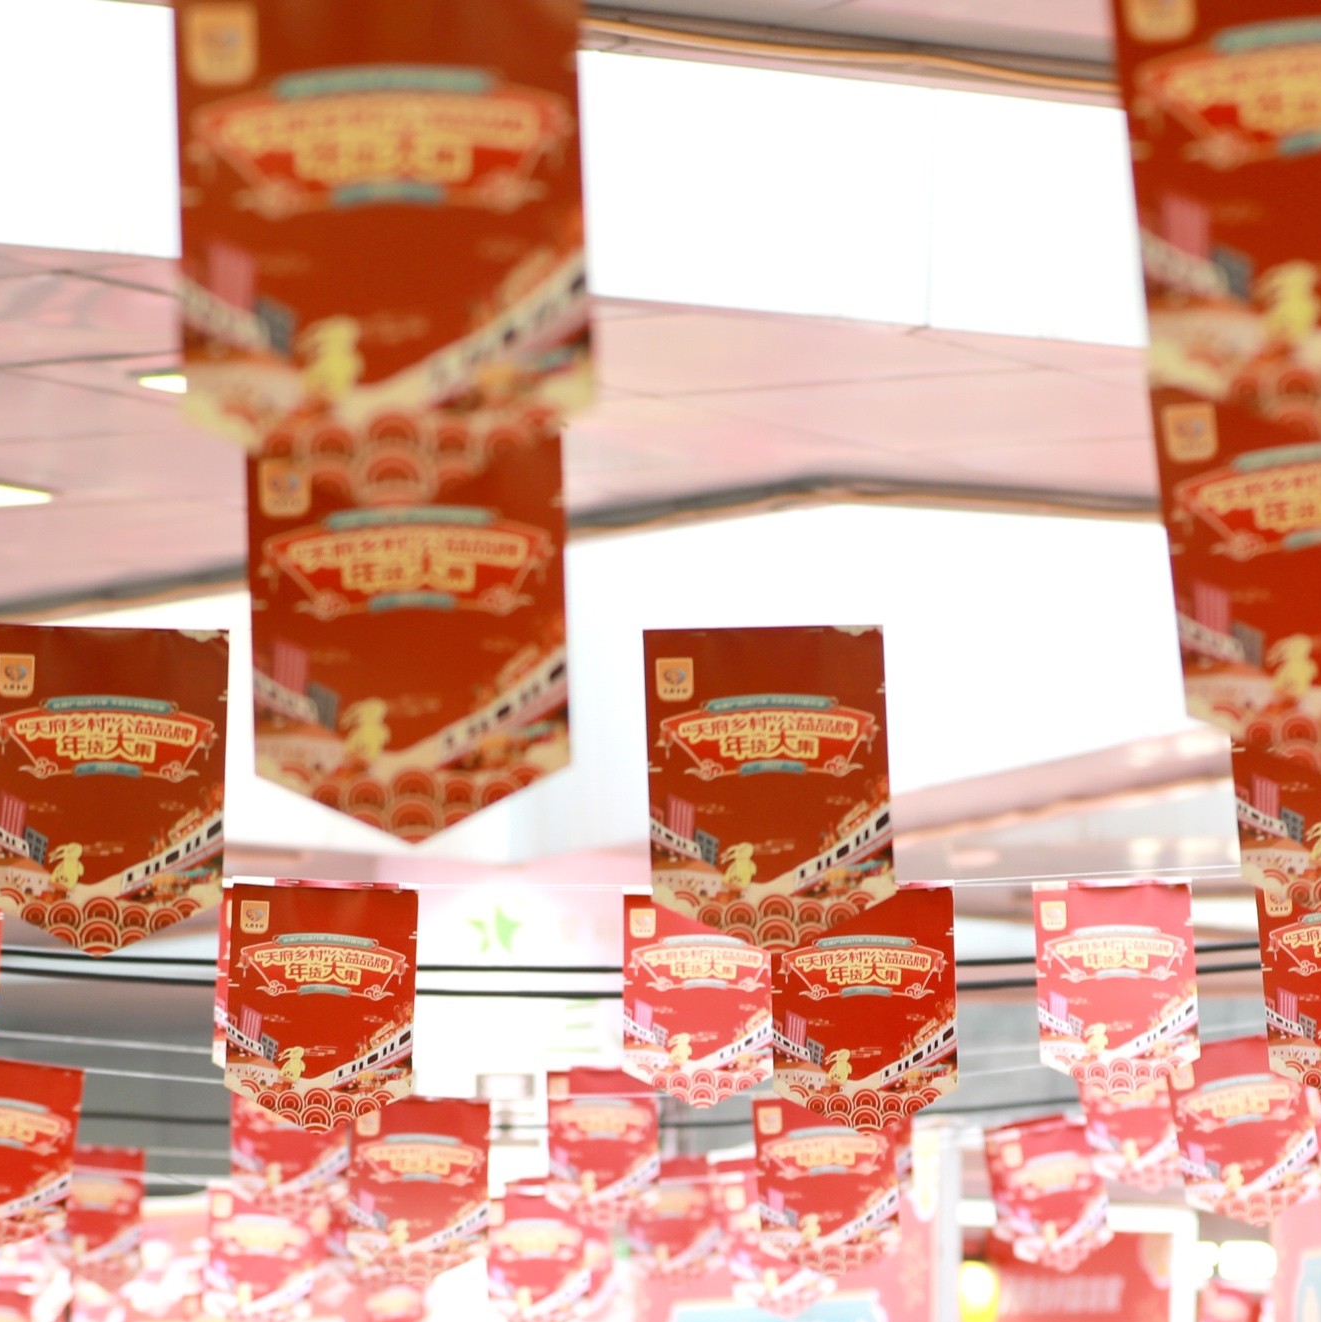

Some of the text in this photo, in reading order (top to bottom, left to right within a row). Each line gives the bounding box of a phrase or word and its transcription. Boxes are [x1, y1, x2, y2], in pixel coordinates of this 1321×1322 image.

[287, 961, 361, 983] 年货大集
[828, 962, 901, 982] 年货大集
